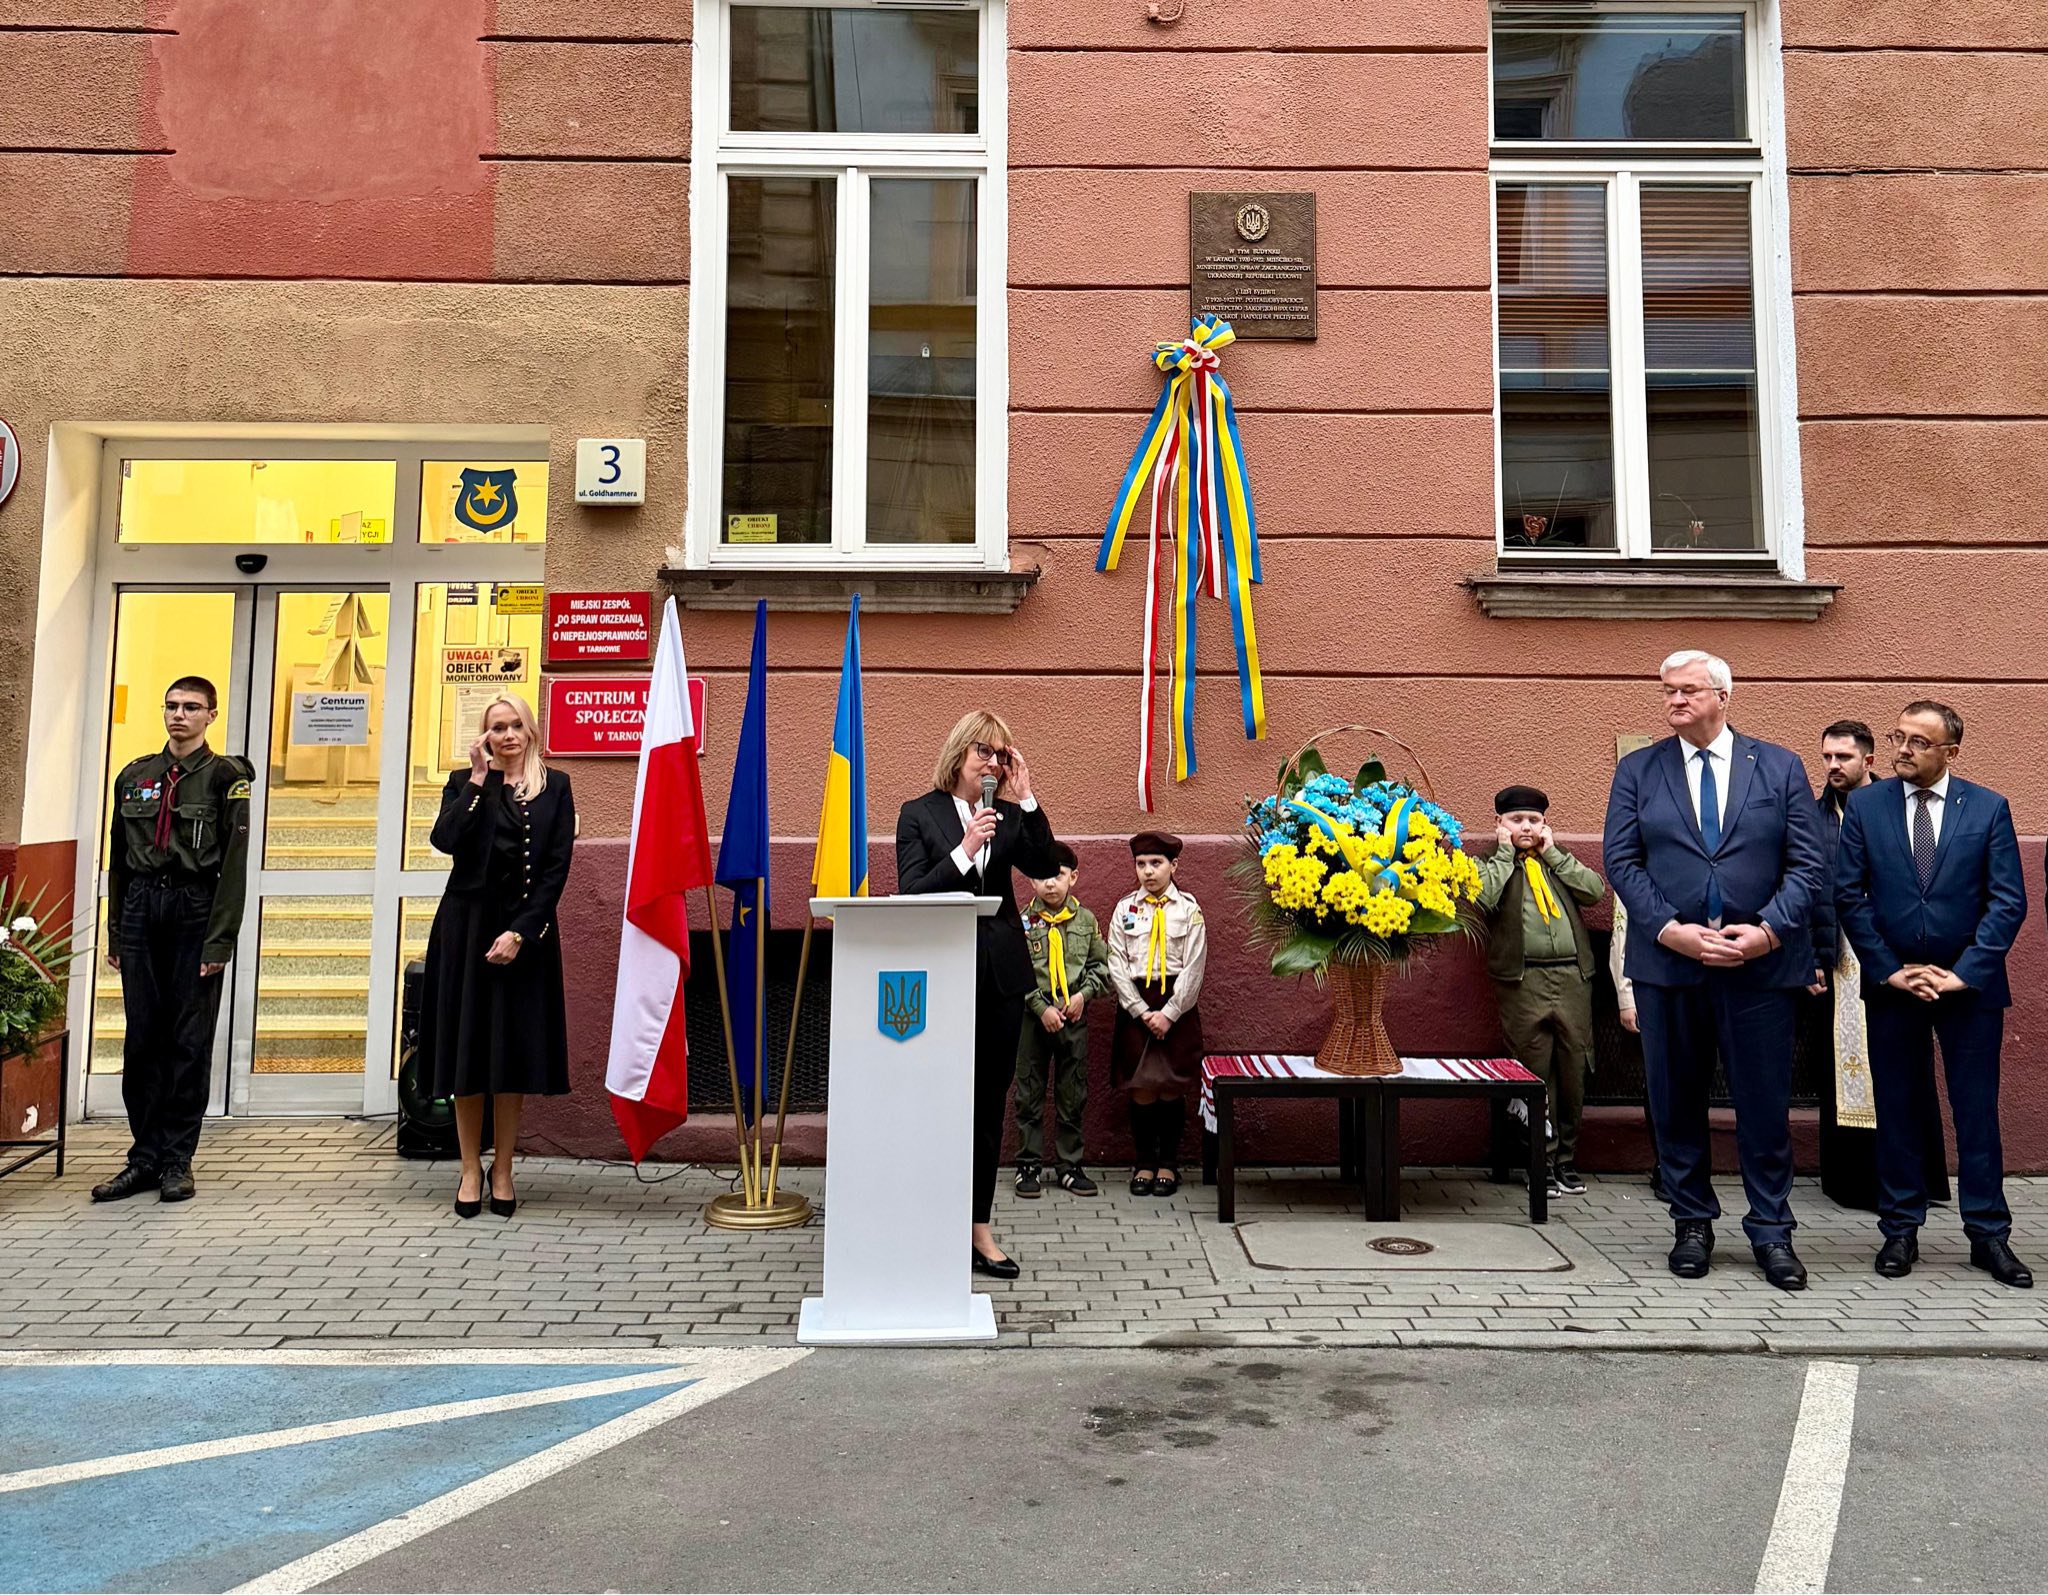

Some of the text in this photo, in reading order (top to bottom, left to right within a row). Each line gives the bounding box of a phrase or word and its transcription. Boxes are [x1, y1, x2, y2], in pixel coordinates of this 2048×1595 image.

[598, 445, 621, 484] 3
[570, 597, 632, 610] MIEJSKI ZESPÓŁ
[558, 614, 644, 624] DO SPRAW ORZEKANIA
[552, 628, 648, 641] O NIEPEŁNOSPRAWNOŚCI
[447, 650, 494, 660] UWAGA!
[446, 663, 492, 673] OBIEKT
[320, 697, 365, 705] Centrum
[565, 690, 636, 705] CENTRUM
[575, 710, 646, 724] SPOŁECZN
[594, 731, 604, 741] W
